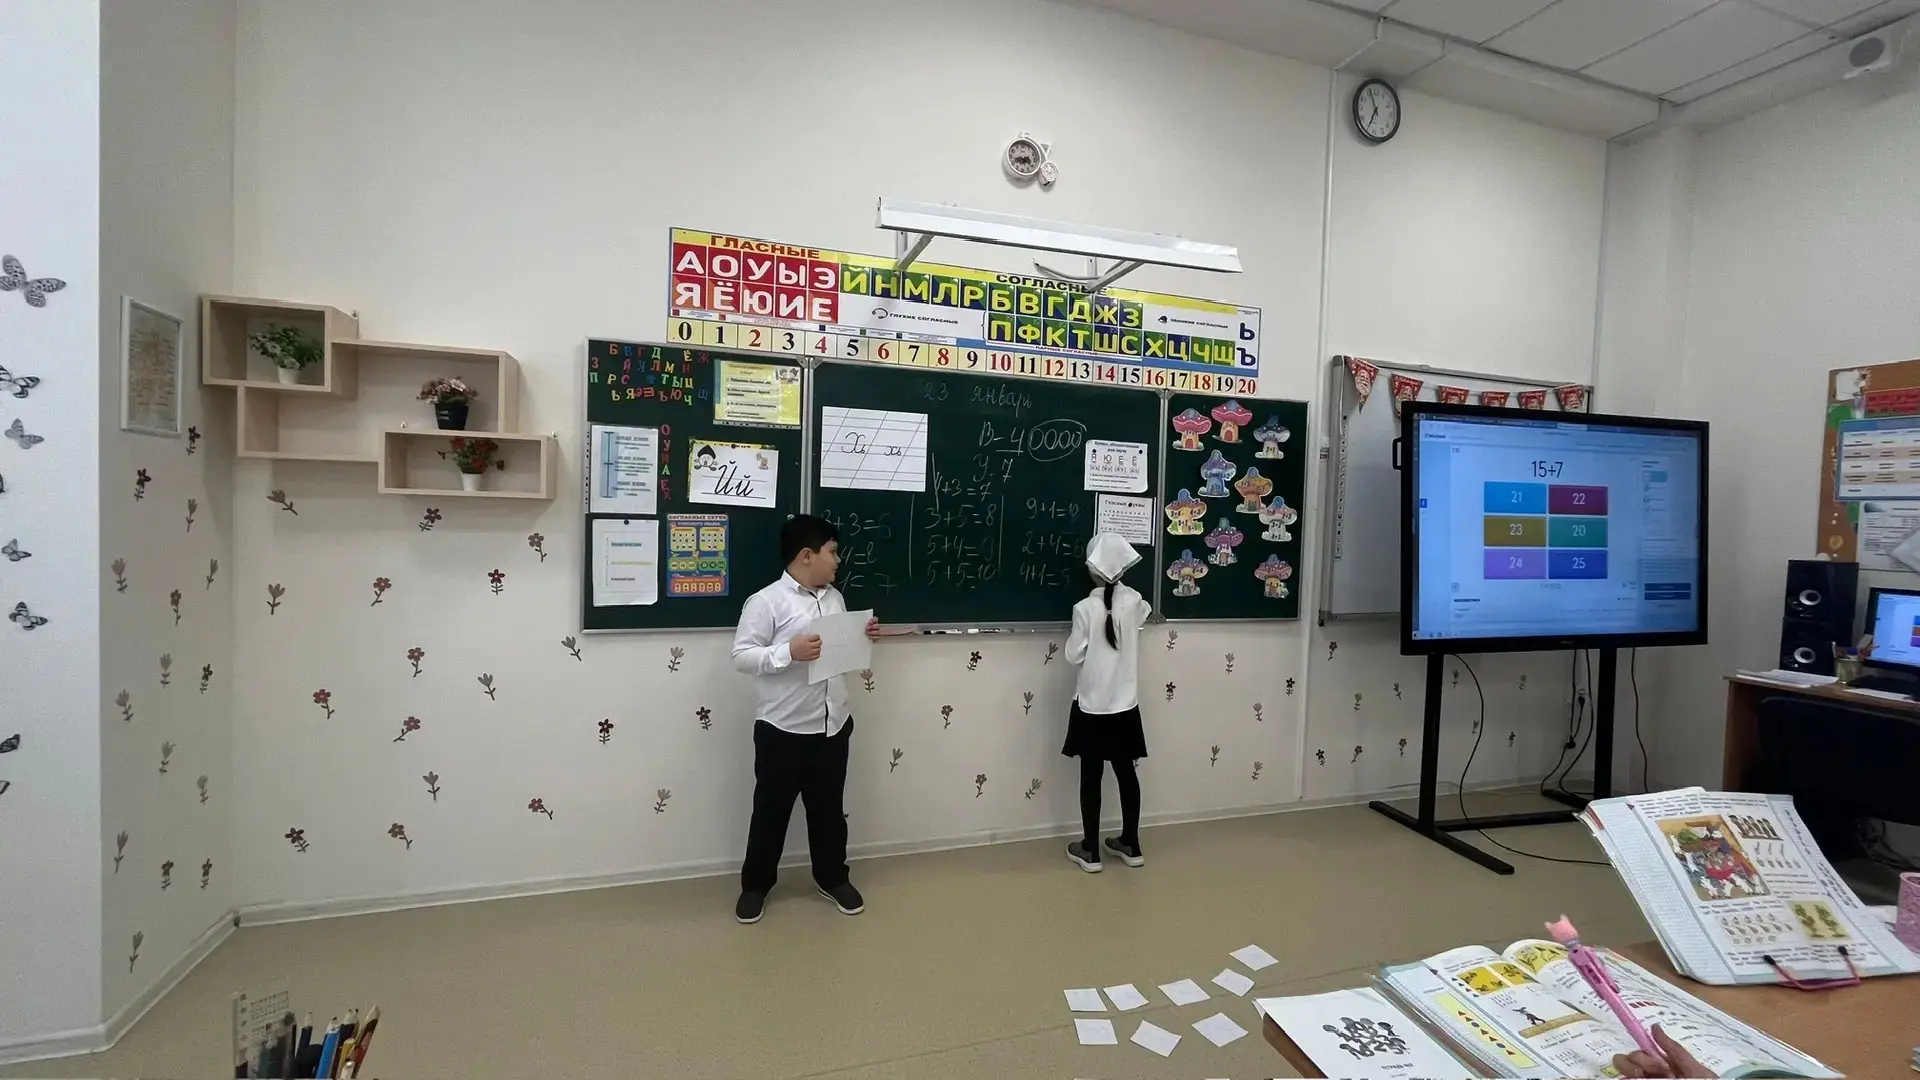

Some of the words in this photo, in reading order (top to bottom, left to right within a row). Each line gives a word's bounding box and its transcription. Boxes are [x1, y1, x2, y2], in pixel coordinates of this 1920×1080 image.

[711, 235, 820, 259] ГЛАСНЫЕ
[676, 251, 705, 274] А
[712, 255, 738, 277] О
[747, 259, 771, 280] У
[779, 263, 806, 286] Ы
[813, 267, 836, 289] Э
[676, 283, 700, 307] Я
[714, 281, 735, 310] Ё
[743, 291, 772, 314] Ю
[780, 294, 804, 318] И
[812, 298, 832, 321] Е
[843, 266, 867, 294] Й
[875, 275, 897, 297] Н
[905, 278, 928, 301] М
[933, 283, 958, 305] Л
[964, 286, 984, 307] Р
[992, 289, 1012, 311] Б
[1020, 292, 1039, 314] В
[1047, 296, 1064, 317] Г
[1069, 301, 1092, 323] Д
[1095, 304, 1118, 325] Ж
[1123, 308, 1139, 327] З
[890, 313, 916, 321] ГЛУХИЕ
[917, 316, 959, 325] СОГЛАСНЫЕ
[1240, 322, 1255, 340] Ь
[991, 320, 1011, 341] П
[1017, 324, 1041, 343] Ф
[1047, 327, 1065, 346] К
[1072, 329, 1090, 349] Т
[1094, 332, 1117, 353] Ш
[1121, 335, 1139, 355] С
[1145, 338, 1163, 357] Х
[1168, 340, 1188, 361] Ц
[1193, 343, 1210, 363] Ч
[1214, 345, 1235, 367] Щ
[678, 321, 692, 341] 0
[716, 326, 725, 345] 1
[748, 329, 762, 347] 2
[782, 332, 795, 350] 3
[814, 336, 828, 353] 4
[846, 339, 859, 356] 5
[877, 342, 890, 360] 6
[908, 345, 920, 363] 7
[937, 348, 949, 366] 8
[967, 351, 978, 368] 9
[991, 353, 1012, 372] 10
[1019, 356, 1036, 374] 11
[1045, 359, 1064, 377] 12
[1071, 362, 1090, 379] 13
[1096, 365, 1115, 381] 14
[1122, 367, 1140, 383] 15
[1146, 369, 1164, 386] 16
[1169, 372, 1188, 388] 17
[1193, 374, 1211, 390] 18
[1216, 376, 1234, 391] 19
[1238, 378, 1256, 394] 20
[1236, 347, 1256, 366] Ъ
[925, 382, 949, 400] 23
[971, 384, 1033, 418] январь
[1531, 460, 1564, 479] 15+7
[1511, 490, 1522, 503] 21
[1572, 493, 1586, 505] 22
[1509, 523, 1523, 536] 23
[1572, 525, 1587, 537] 20
[1509, 556, 1523, 569] 24
[1572, 557, 1586, 569] 25
